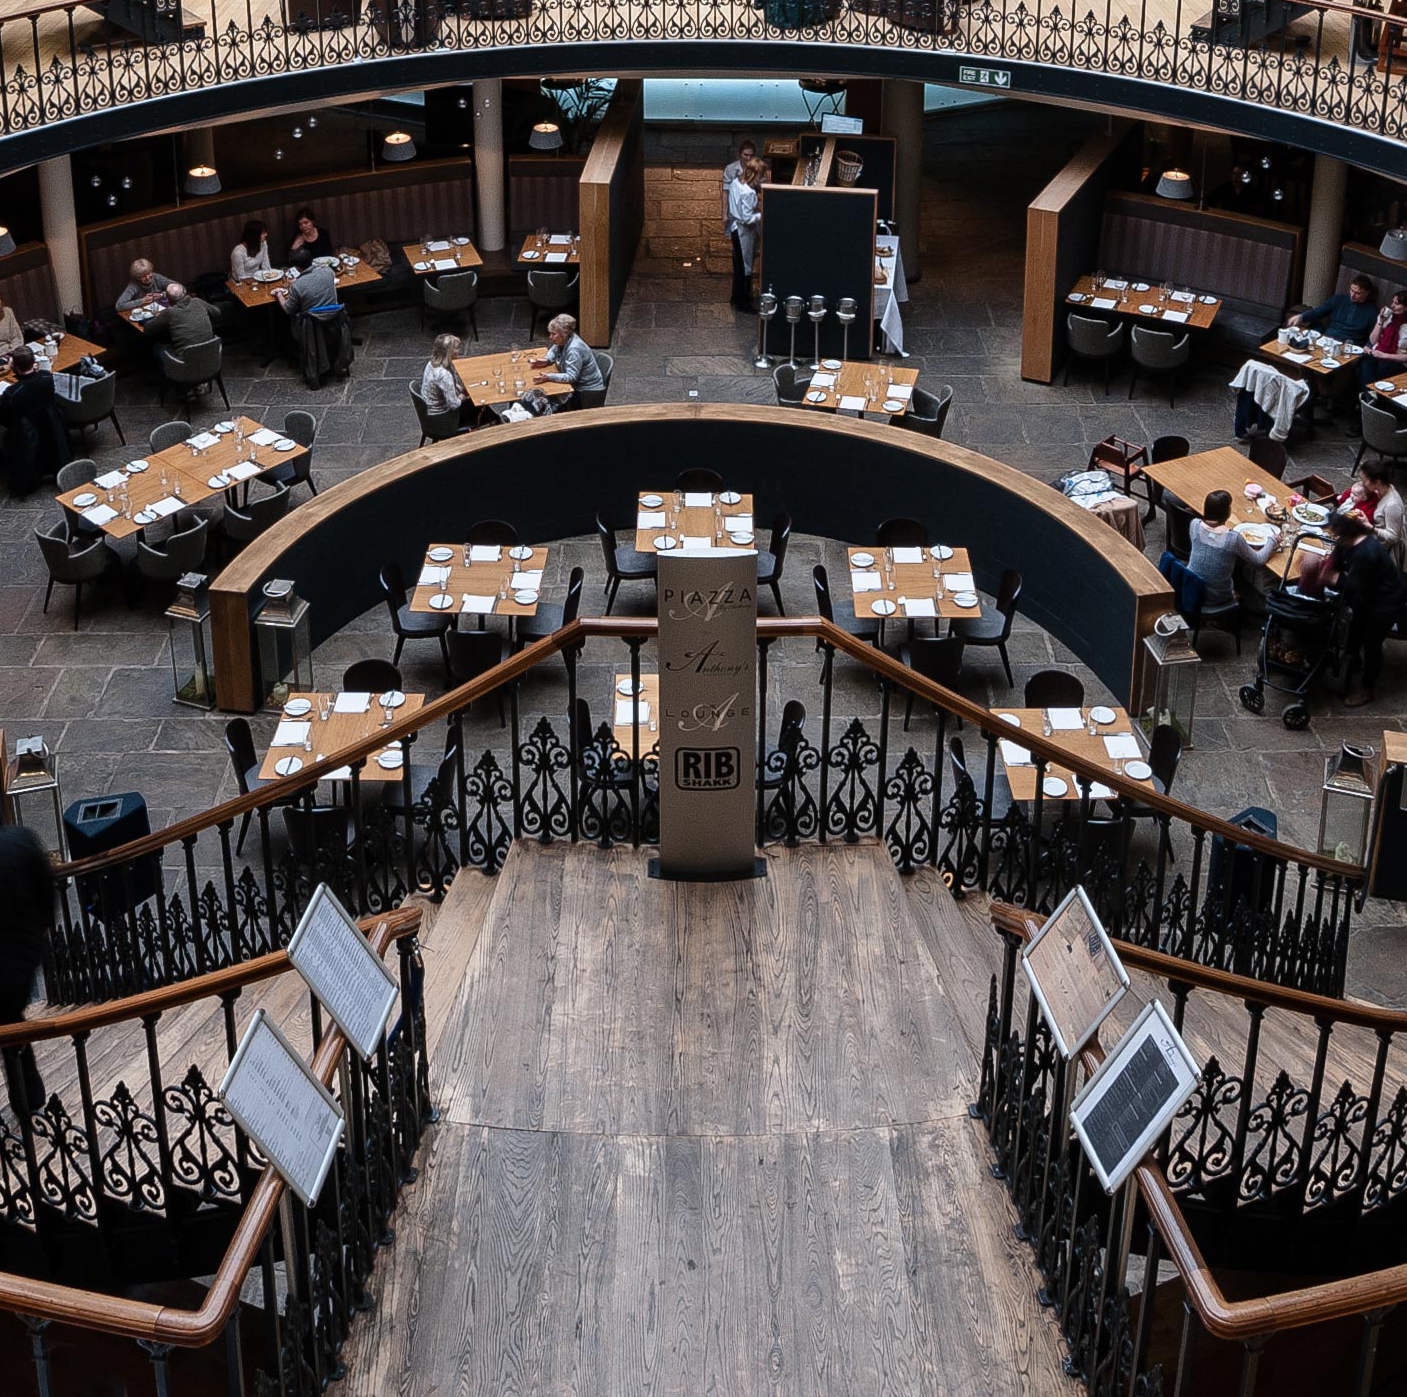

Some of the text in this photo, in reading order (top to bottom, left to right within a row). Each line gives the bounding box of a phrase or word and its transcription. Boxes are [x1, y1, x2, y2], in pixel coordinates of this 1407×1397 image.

[664, 588, 752, 604] PIAZZA
[665, 707, 751, 719] LOUNGE
[683, 752, 735, 780] RIB
[683, 778, 733, 788] SHAKK
